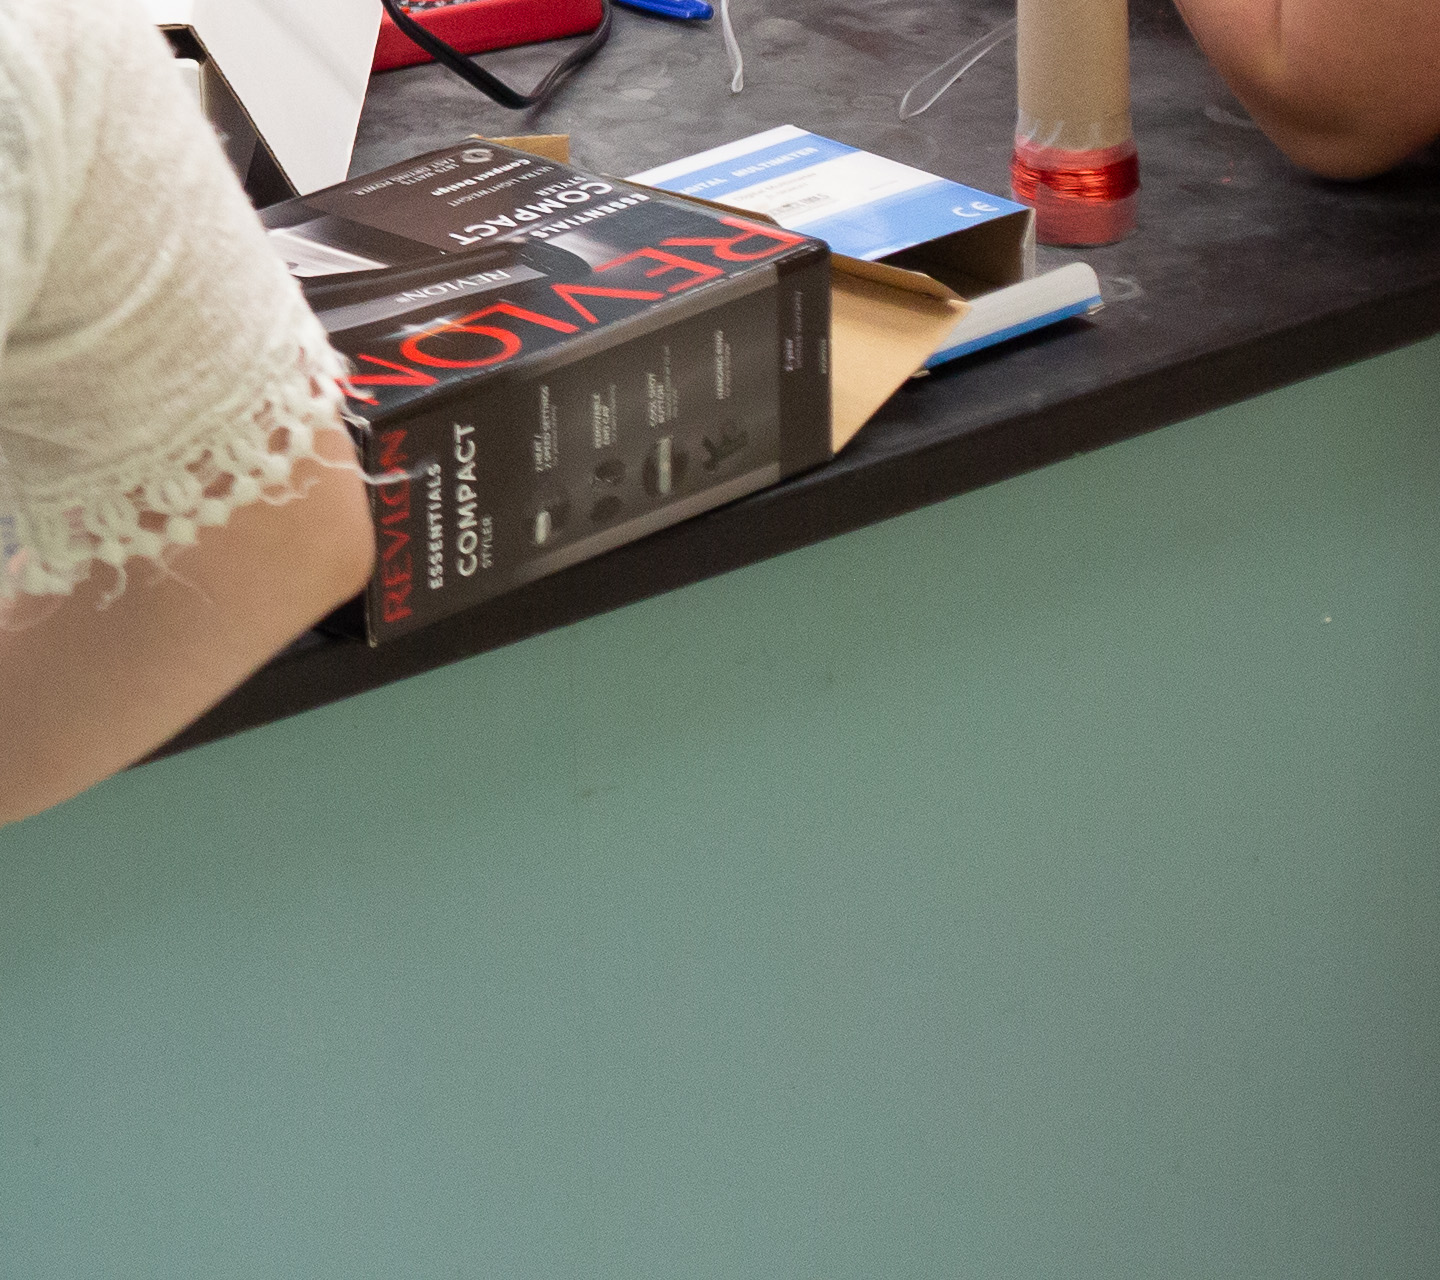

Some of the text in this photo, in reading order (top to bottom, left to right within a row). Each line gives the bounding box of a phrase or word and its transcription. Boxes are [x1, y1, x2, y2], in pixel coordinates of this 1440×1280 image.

[431, 158, 532, 197] Compact Design
[534, 175, 588, 197] STYLER
[731, 146, 819, 177] MULTIMETER
[448, 182, 613, 246] COMPACT
[530, 193, 651, 240] ESSENTIALS
[341, 217, 807, 406] REVLON
[401, 269, 510, 302] REVLON
[380, 429, 414, 623] REVLON
[427, 463, 443, 590] ESSENTIALS
[454, 422, 479, 577] COMPACT
